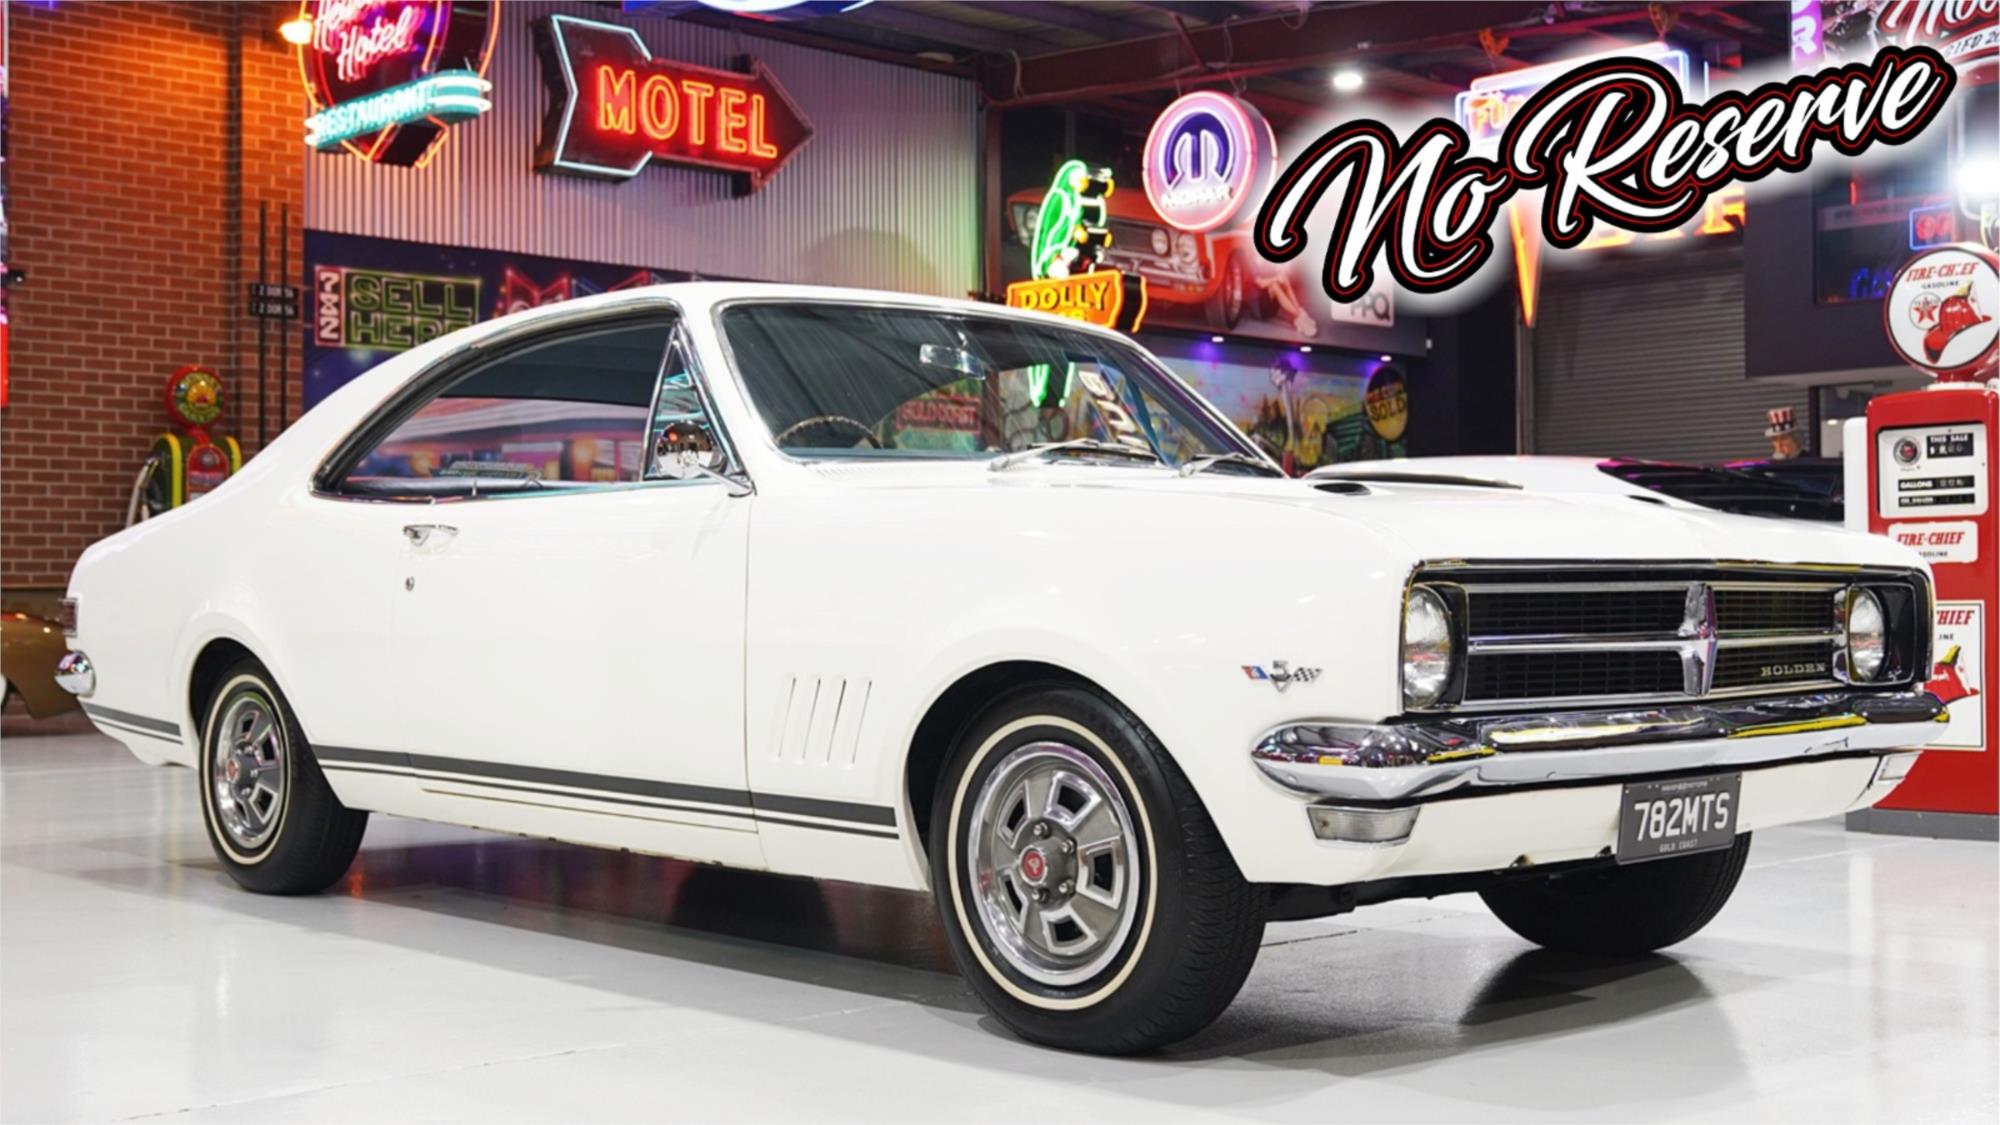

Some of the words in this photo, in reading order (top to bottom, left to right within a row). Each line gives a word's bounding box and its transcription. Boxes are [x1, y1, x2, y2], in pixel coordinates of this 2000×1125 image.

[337, 5, 412, 80] Hotel
[597, 65, 778, 159] MOTEL
[351, 276, 474, 319] SELL
[1020, 282, 1105, 311] DOLLY
[1897, 531, 1966, 546] FIRE-CHIEF
[1760, 663, 1827, 677] HOLDEN
[1633, 791, 1731, 842] 782MTS
